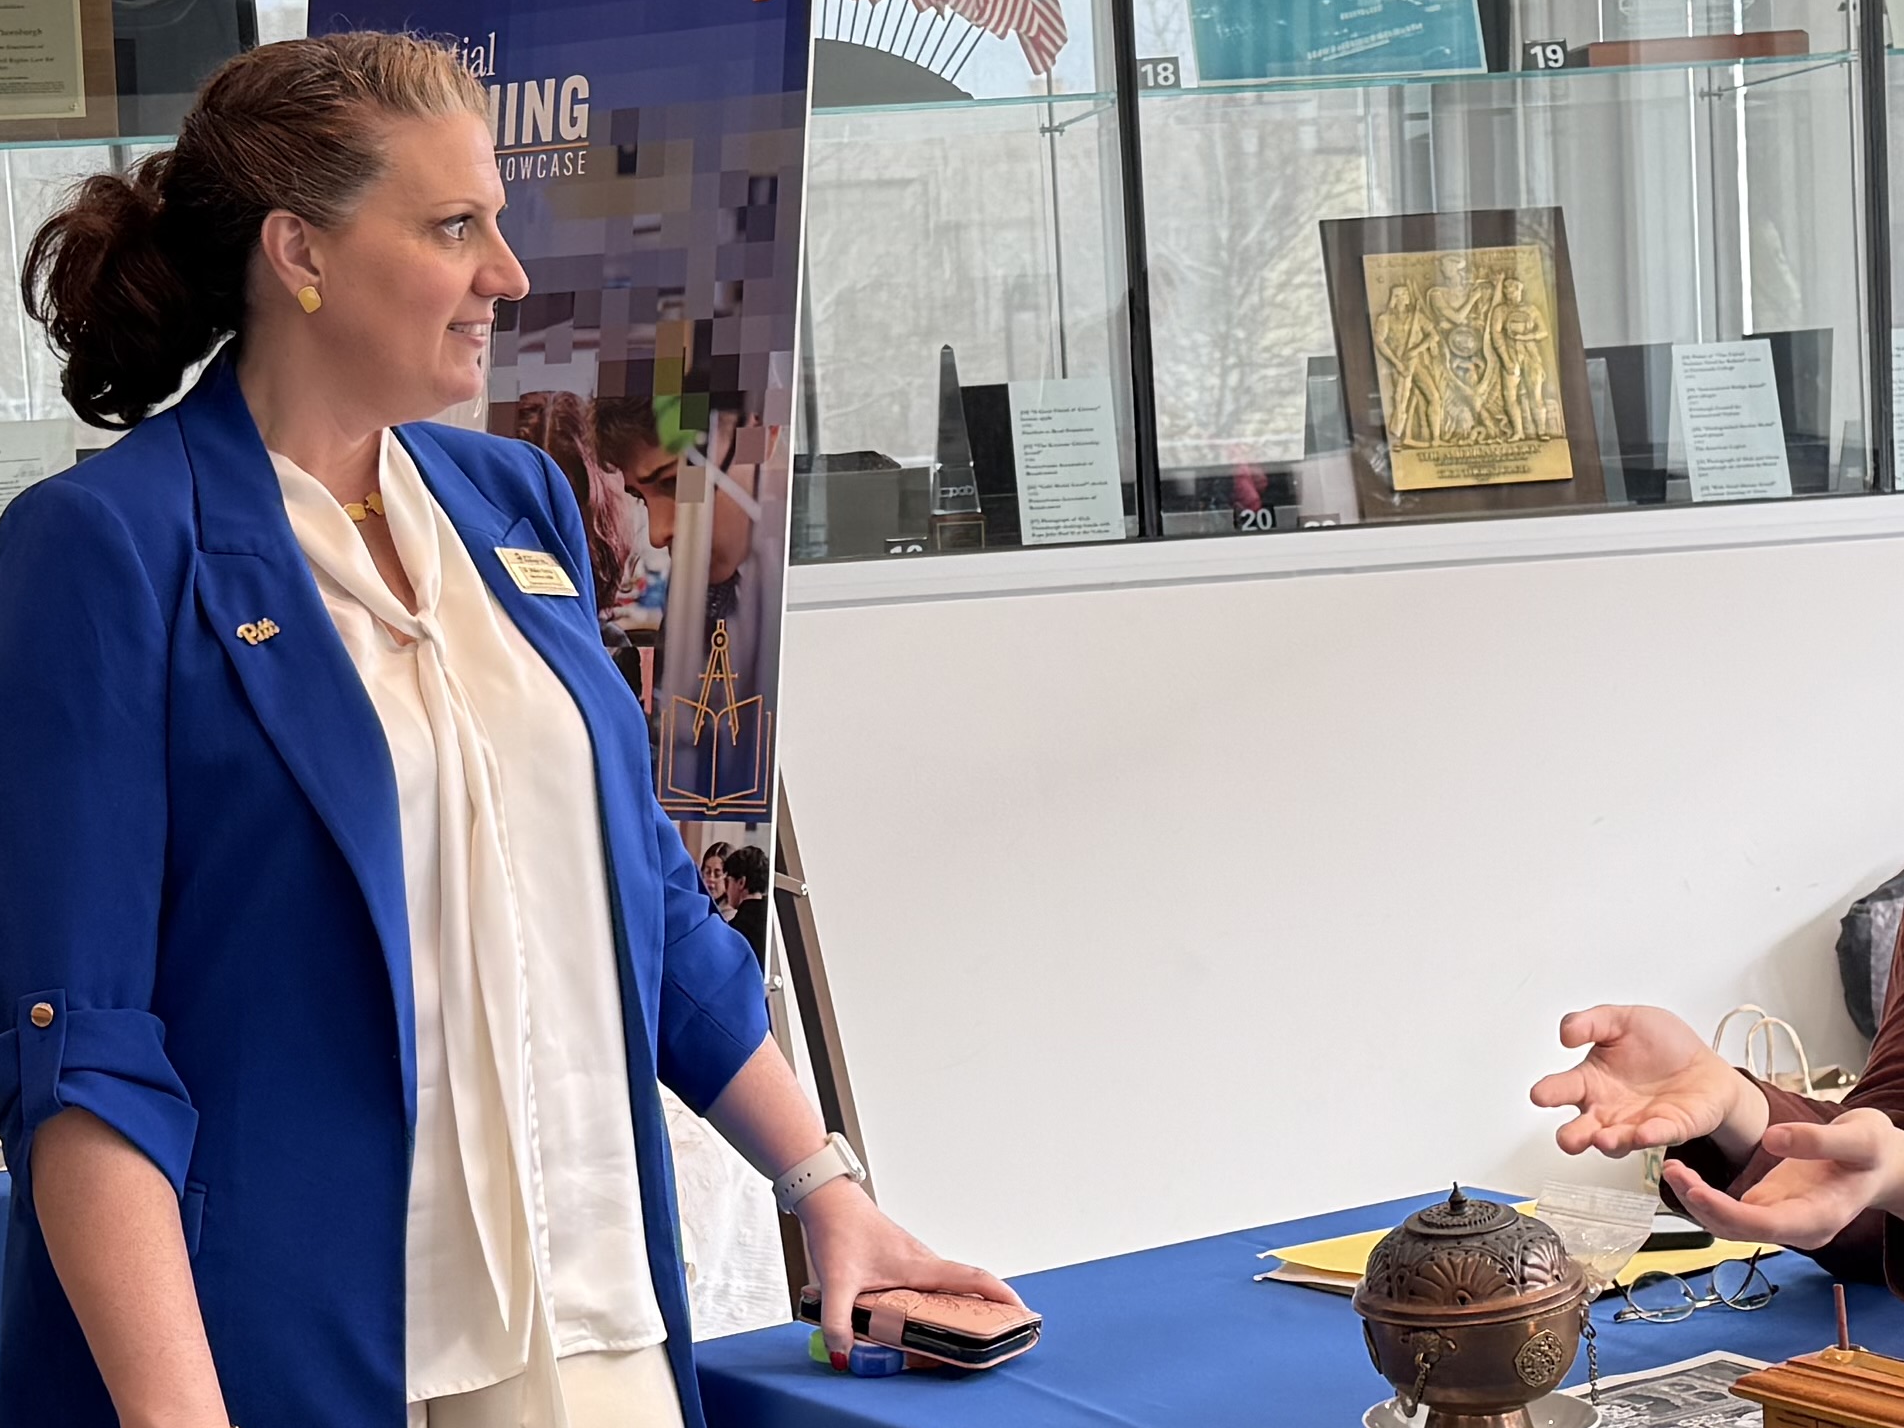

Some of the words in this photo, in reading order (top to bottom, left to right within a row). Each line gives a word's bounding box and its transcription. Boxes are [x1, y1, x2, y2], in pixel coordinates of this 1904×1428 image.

[1530, 44, 1564, 69] 19
[1141, 62, 1175, 86] 18
[497, 150, 587, 182] OWCASE
[1240, 508, 1273, 531] 20
